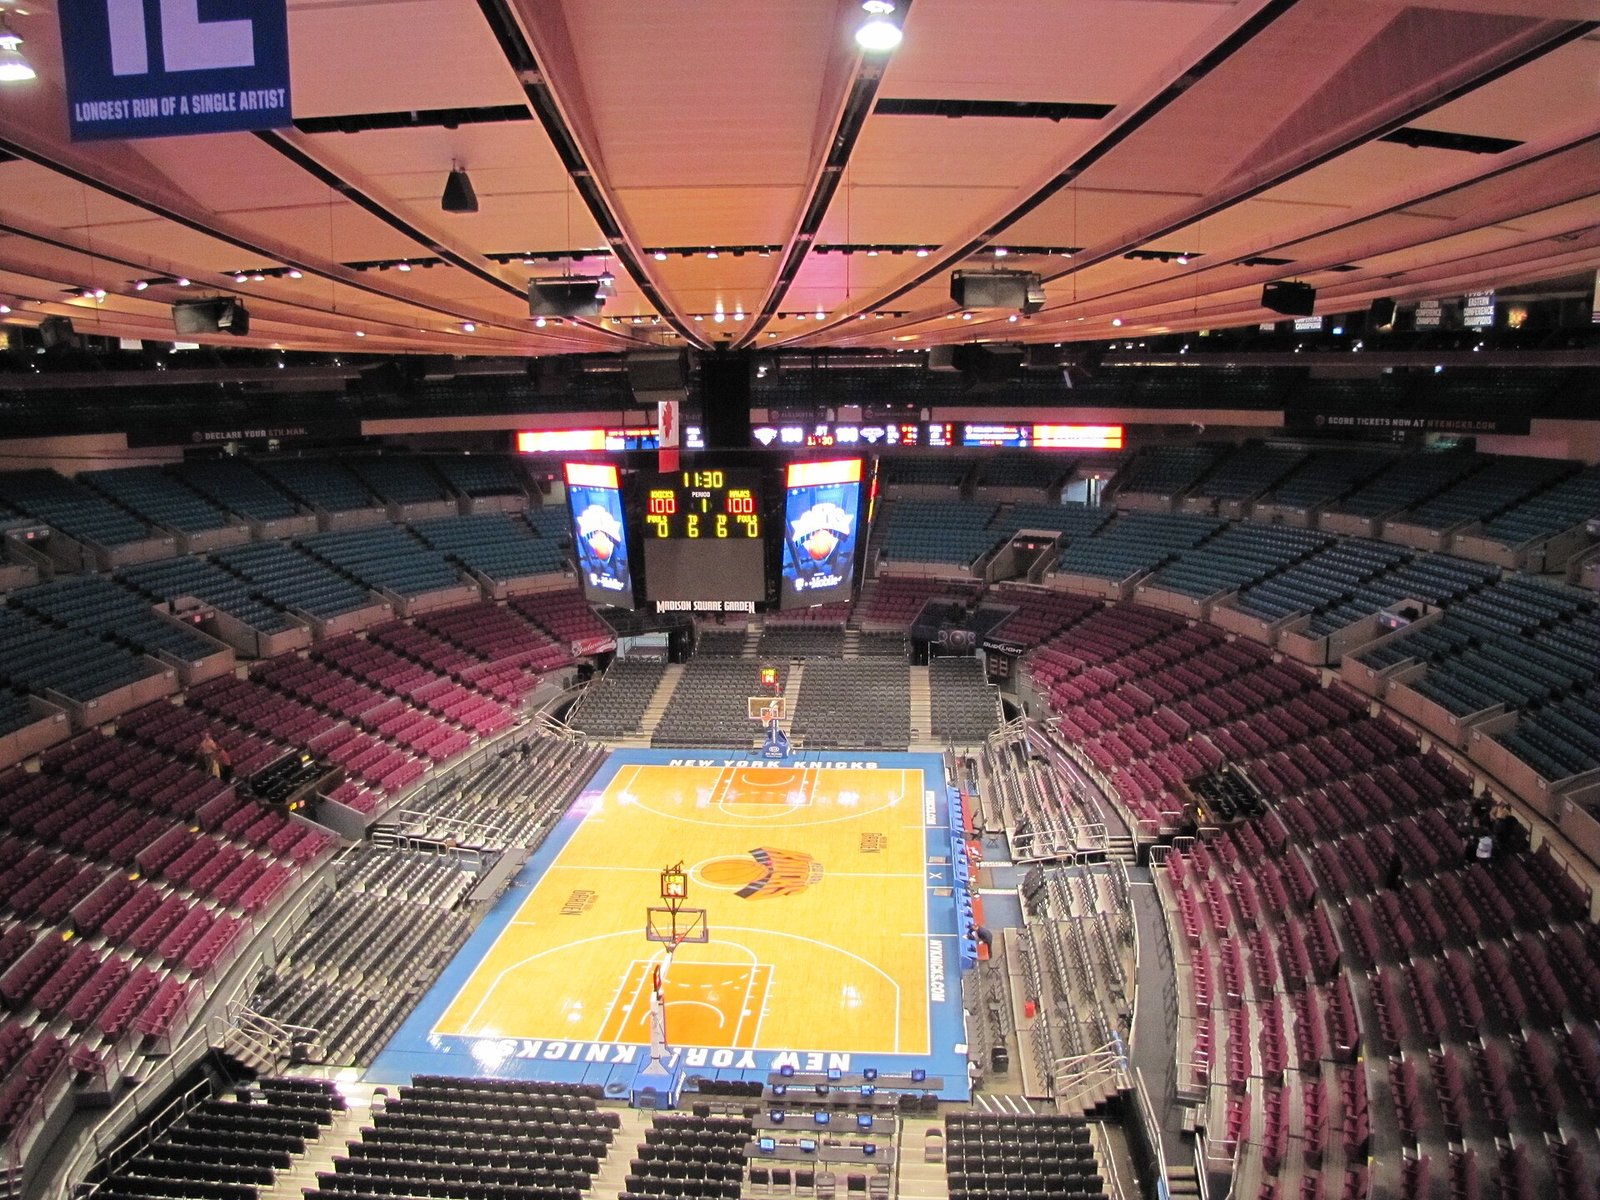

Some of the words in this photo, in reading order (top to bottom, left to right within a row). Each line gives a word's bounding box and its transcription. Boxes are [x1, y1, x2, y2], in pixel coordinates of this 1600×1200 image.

[75, 99, 132, 122] LONGEST
[133, 97, 159, 118] RUN
[161, 95, 177, 116] OF
[180, 96, 190, 116] A
[192, 92, 237, 114] SINGLE
[239, 88, 285, 111] ARTIST
[1328, 416, 1354, 425] SCORE
[1357, 417, 1390, 426] TICKETS
[1392, 418, 1411, 427] NOW
[1412, 419, 1425, 428] AT
[205, 431, 242, 440] DECLARE
[244, 430, 267, 438] YOUR
[683, 471, 723, 488] 11:30
[650, 498, 675, 513] 100
[702, 498, 707, 513] 1
[727, 498, 753, 513] 100
[646, 514, 668, 524] FOULS
[687, 514, 698, 525] TO
[717, 514, 728, 525] TO
[736, 514, 758, 523] FOULS
[657, 522, 669, 538] 0
[687, 522, 699, 538] 6
[716, 522, 728, 538] 6
[747, 522, 758, 538] 0
[656, 600, 692, 614] MADISON
[693, 600, 723, 611] SQUARE
[723, 601, 756, 614] GARDEN
[1001, 645, 1023, 654] LIGHT
[669, 759, 714, 767] NEW
[724, 759, 780, 768] YORK
[793, 761, 879, 769] KNICKS
[929, 939, 946, 1002] NYKNICKS.COM
[500, 1038, 638, 1064] KNICKS
[771, 1051, 850, 1072] NEW
